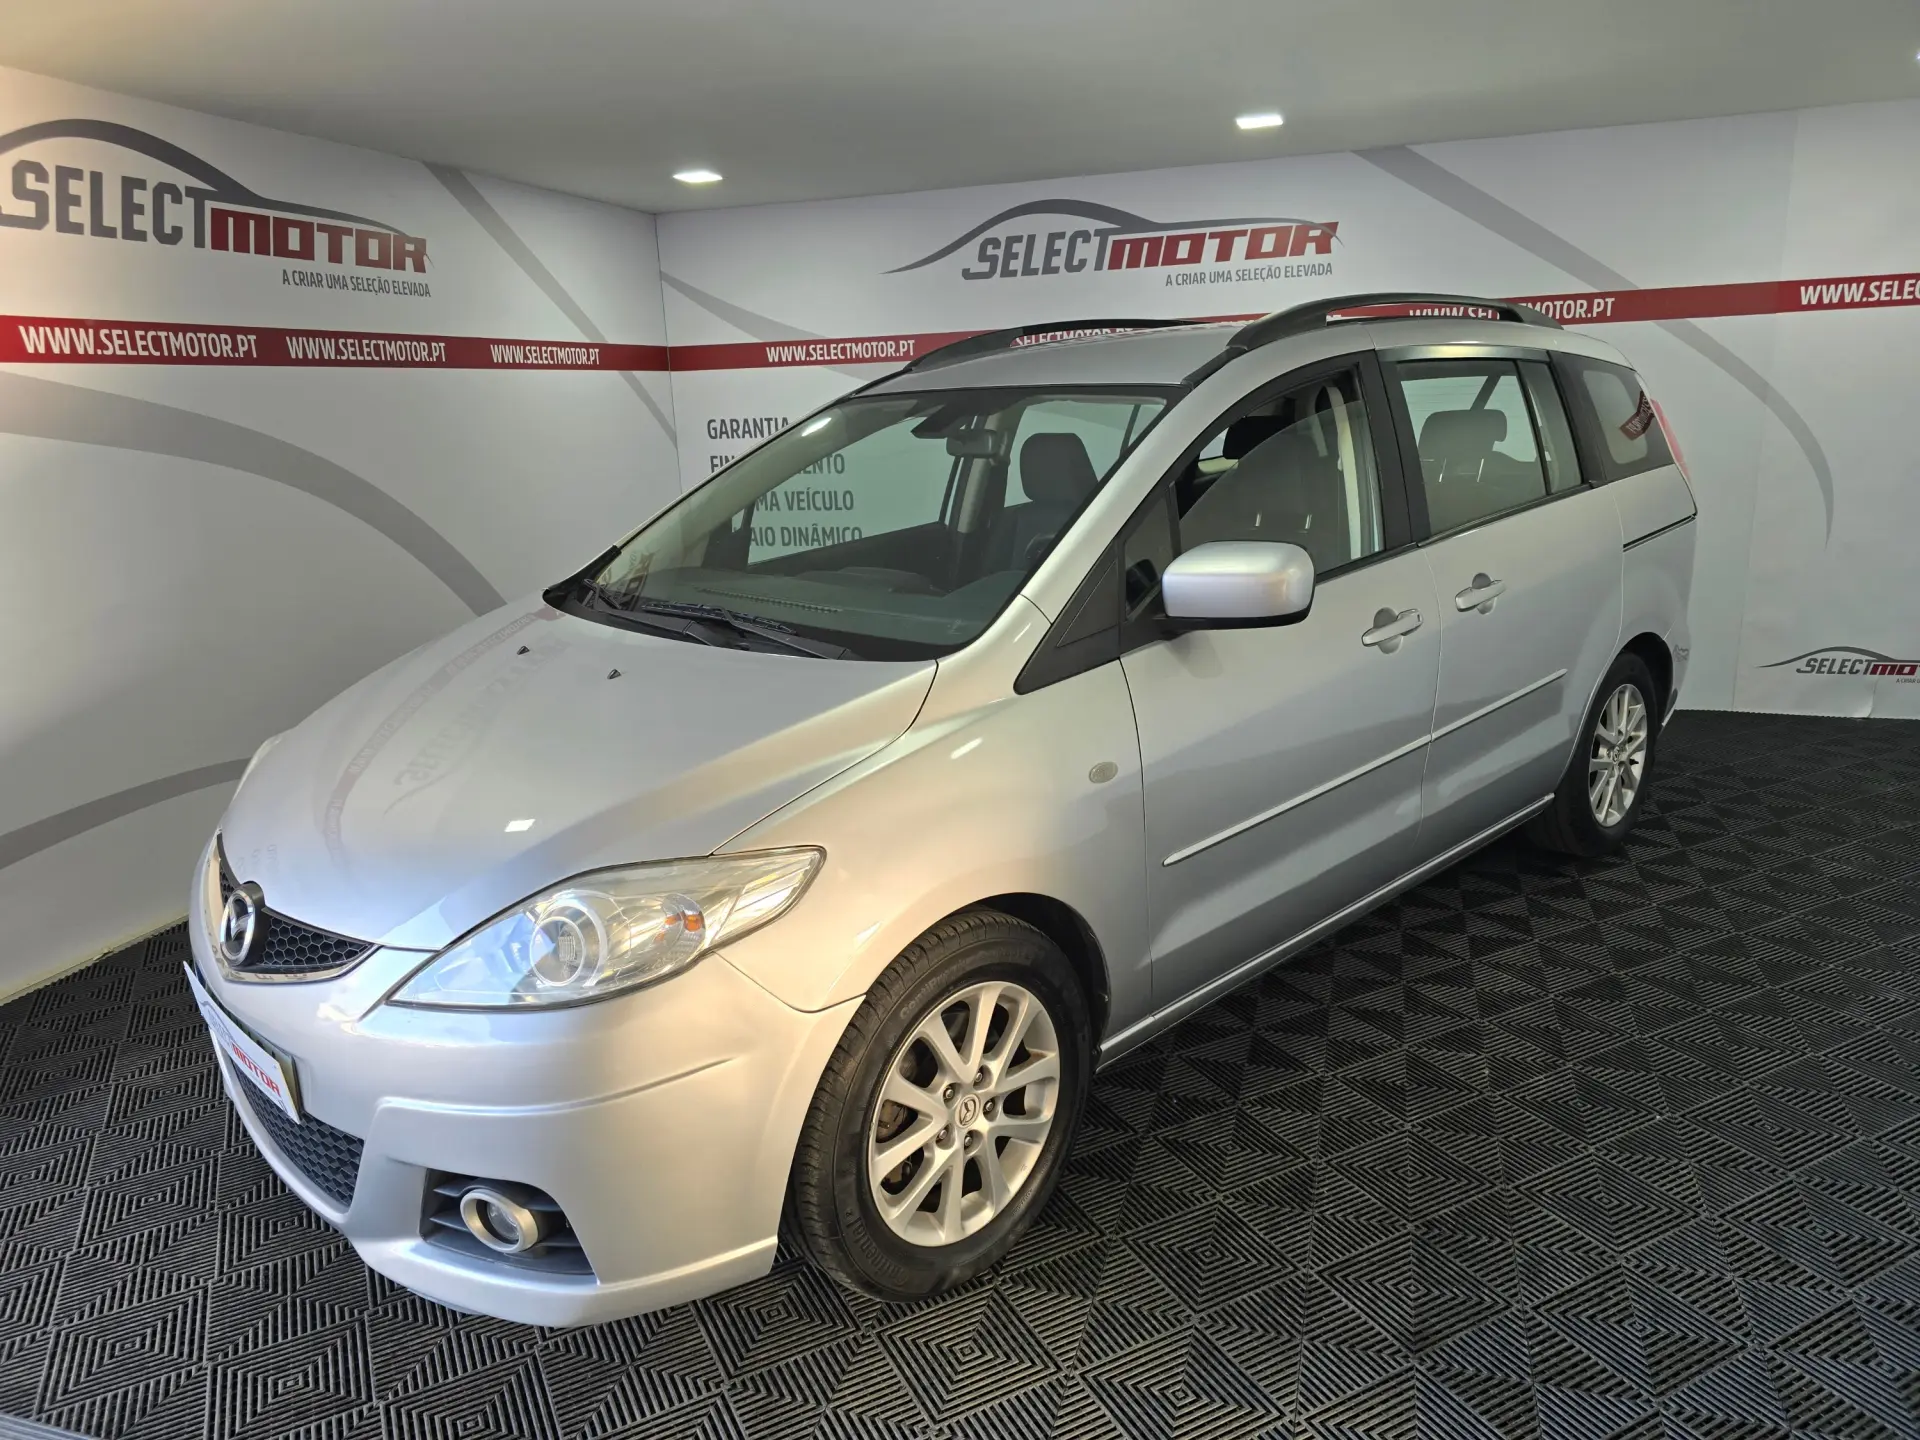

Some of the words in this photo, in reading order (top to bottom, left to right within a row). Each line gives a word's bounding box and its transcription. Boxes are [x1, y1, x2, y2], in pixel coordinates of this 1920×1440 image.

[282, 269, 291, 286] A
[292, 270, 324, 289] CRIAR
[325, 273, 349, 291] UMA
[351, 275, 391, 296] SELEÇÃO
[392, 280, 432, 298] ELEVADA
[1165, 274, 1173, 287] A
[1175, 271, 1207, 286] CRIAR
[1209, 269, 1233, 284] UMA
[1235, 264, 1281, 282] SELEÇÃO
[1284, 262, 1333, 279] ELEVADA
[18, 325, 258, 359] WWW.SELECTMOTOR.PT
[285, 335, 447, 363] WWW.SELECTMOTOR.PT
[765, 339, 916, 363] WWW.SELECTMOTOR.PT
[490, 344, 601, 366] WWW.SELECTMOTOR.PT
[783, 487, 855, 511] VEÍCULO
[1795, 657, 1920, 676] SELECTMO
